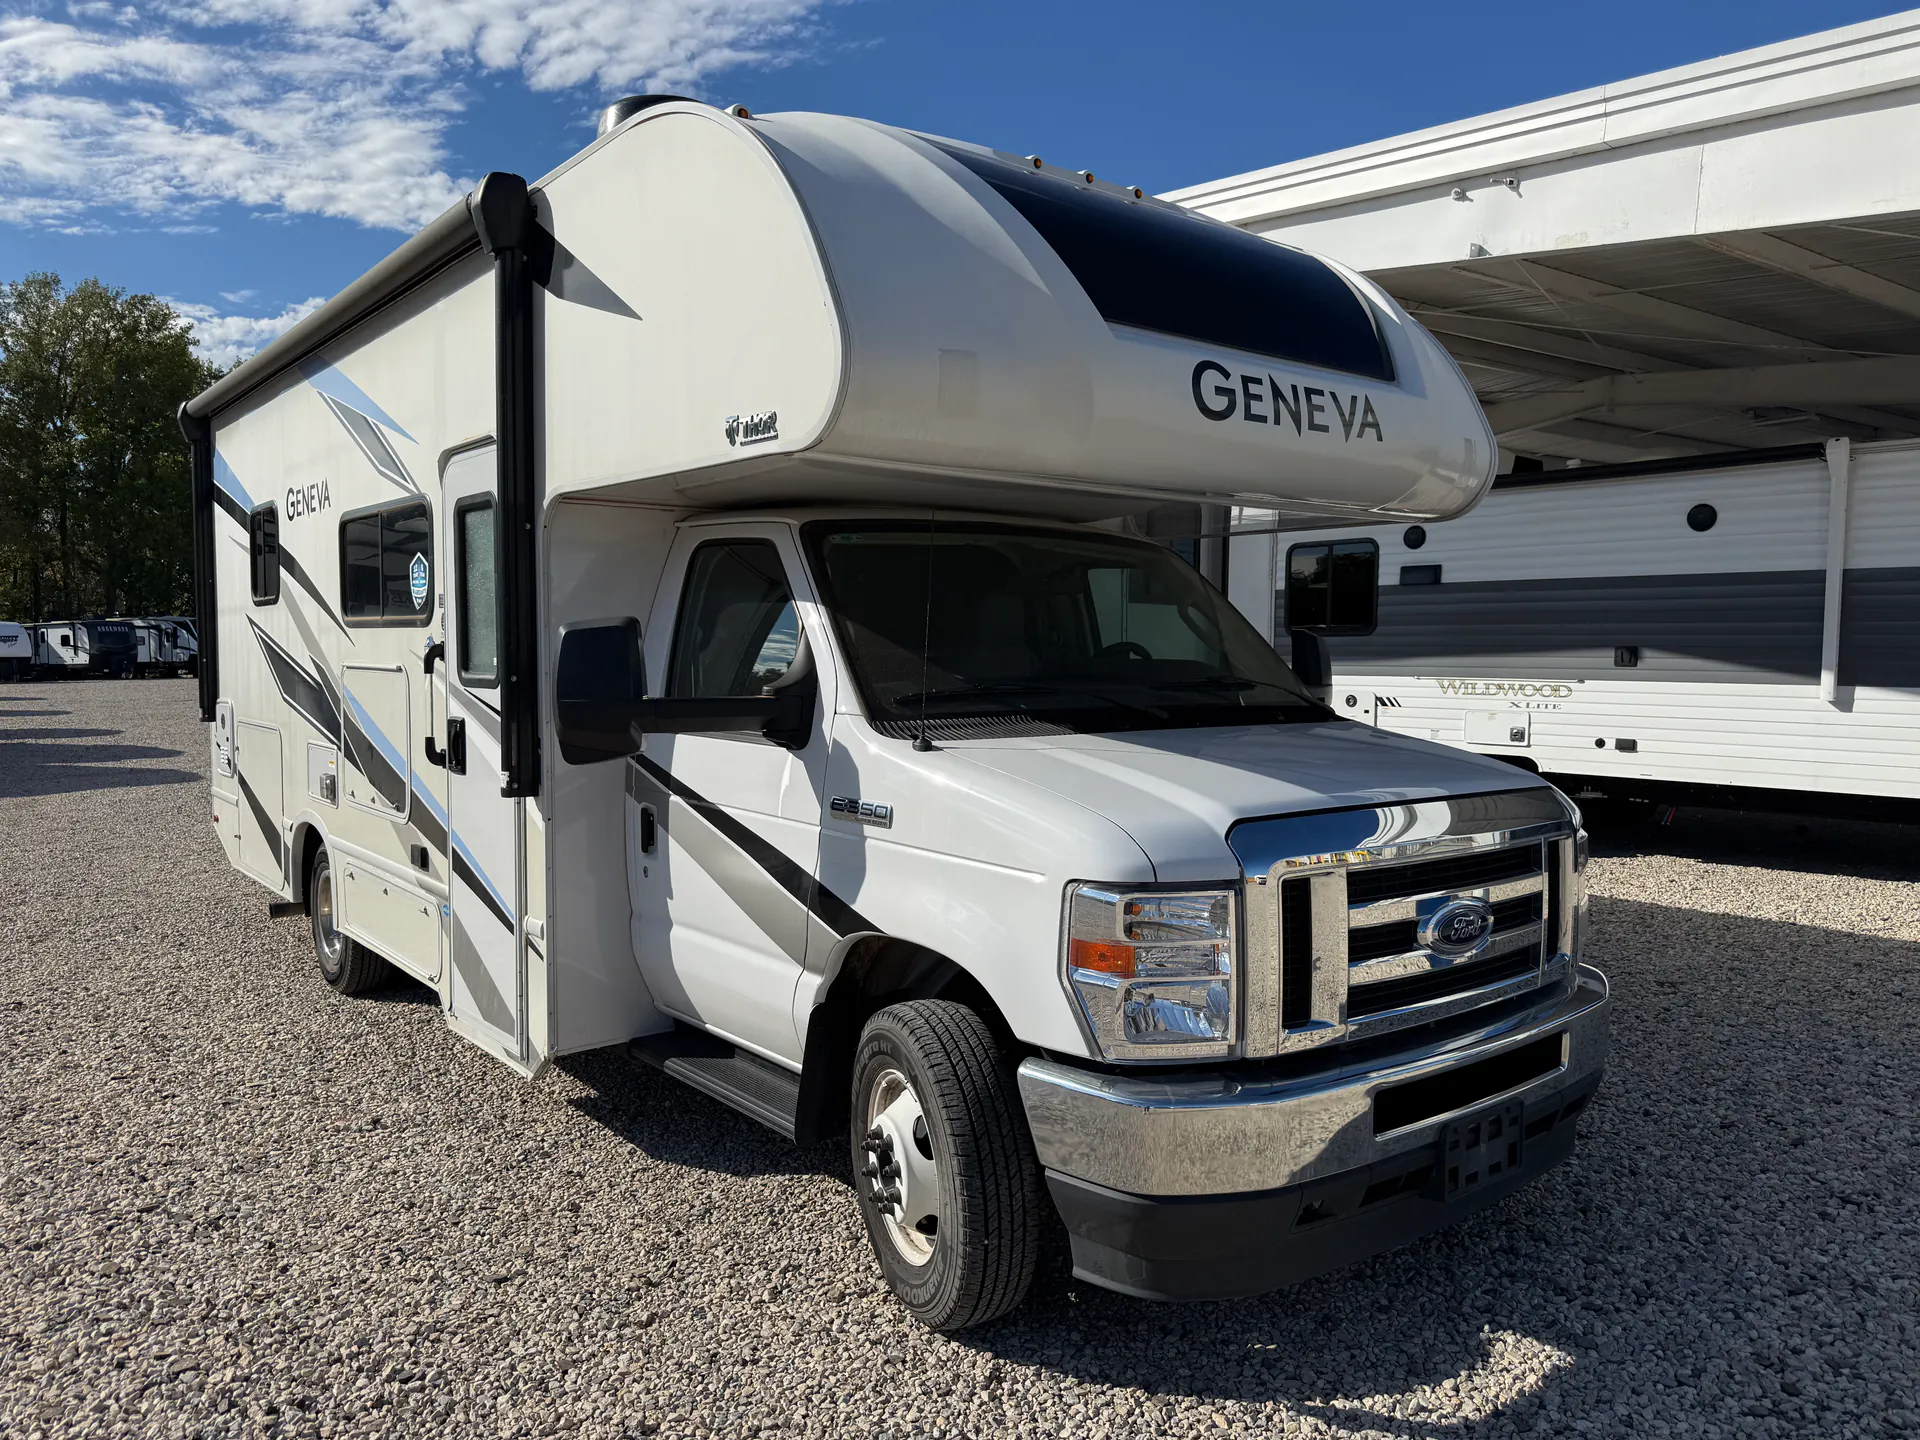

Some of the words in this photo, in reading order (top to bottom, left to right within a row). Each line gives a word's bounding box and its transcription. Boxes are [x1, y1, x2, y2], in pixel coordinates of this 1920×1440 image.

[1191, 359, 1384, 444] GENEVA
[740, 411, 778, 440] THOR
[286, 477, 331, 522] GENEVA
[1436, 679, 1573, 698] WILDWOOD
[1450, 915, 1482, 941] Ford
